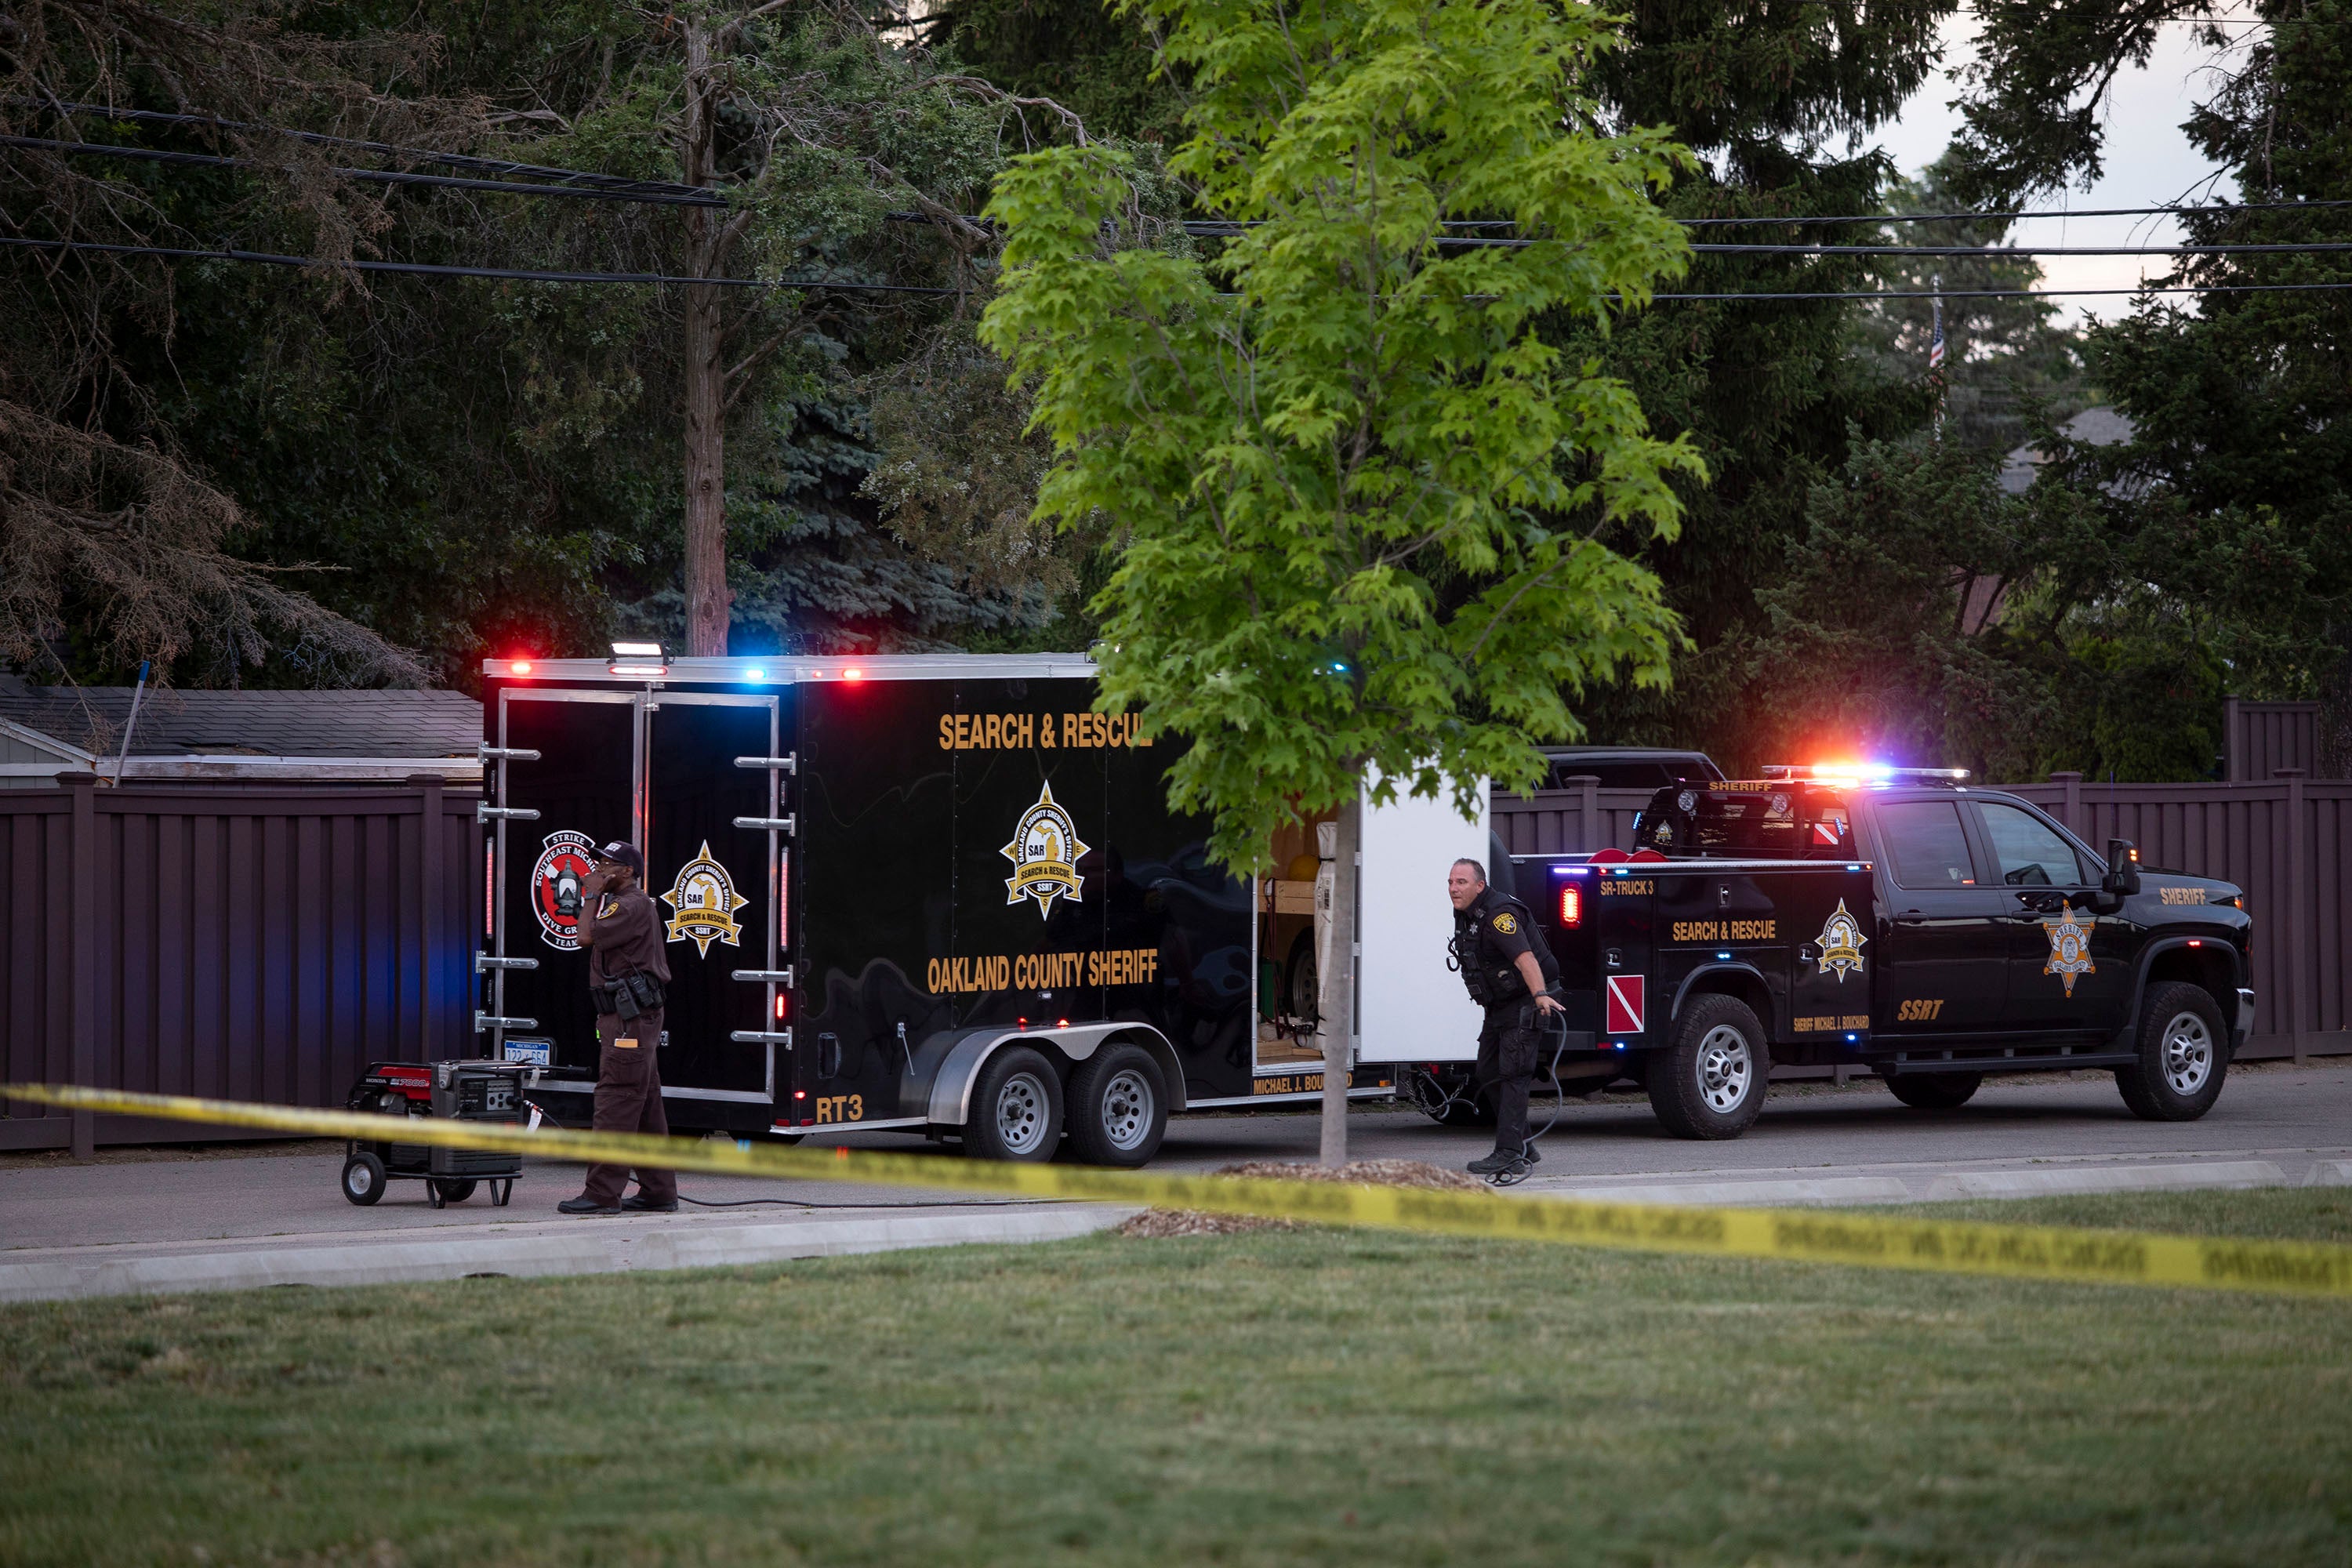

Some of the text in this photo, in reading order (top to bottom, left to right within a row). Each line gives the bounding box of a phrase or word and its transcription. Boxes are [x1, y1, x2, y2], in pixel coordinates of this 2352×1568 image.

[939, 713, 1033, 750] SEARCH
[1040, 713, 1057, 748] &
[1709, 782, 1772, 791] SHERIFF
[553, 834, 585, 844] STRIKE
[1018, 826, 1028, 862] OAKLAND
[1025, 809, 1047, 828] COUNTY
[1029, 845, 1044, 856] SAR
[535, 846, 596, 887] SOUTHEAST MICHI
[1021, 866, 1043, 880] SEARCH
[1049, 866, 1070, 878] RESCUE
[677, 878, 688, 908] OAKLAND
[685, 865, 706, 878] COUNTY
[1037, 883, 1053, 892] SSRT
[1600, 880, 1654, 896] SR-TRUCK 3
[687, 894, 702, 903] SAR
[2159, 887, 2206, 905] SHERIFF
[541, 913, 561, 933] DIVE
[680, 913, 701, 923] SEARCH
[707, 913, 728, 925] RESCUE
[1673, 920, 1775, 941] SEARCH & RESCUE
[2056, 924, 2083, 941] SHERIFF
[927, 949, 1157, 994] OAKLAND COUNTY SHERIFF
[1897, 1000, 1944, 1021] SSRT
[1794, 1018, 1813, 1032] SHERIFF
[1814, 1016, 1836, 1031] MICHAEL
[1842, 1015, 1869, 1030] BOUCHARD
[532, 1051, 546, 1065] 664
[1254, 1077, 1292, 1094] MICHAEL
[1295, 1076, 1301, 1091] J.
[817, 1094, 863, 1123] RT3
